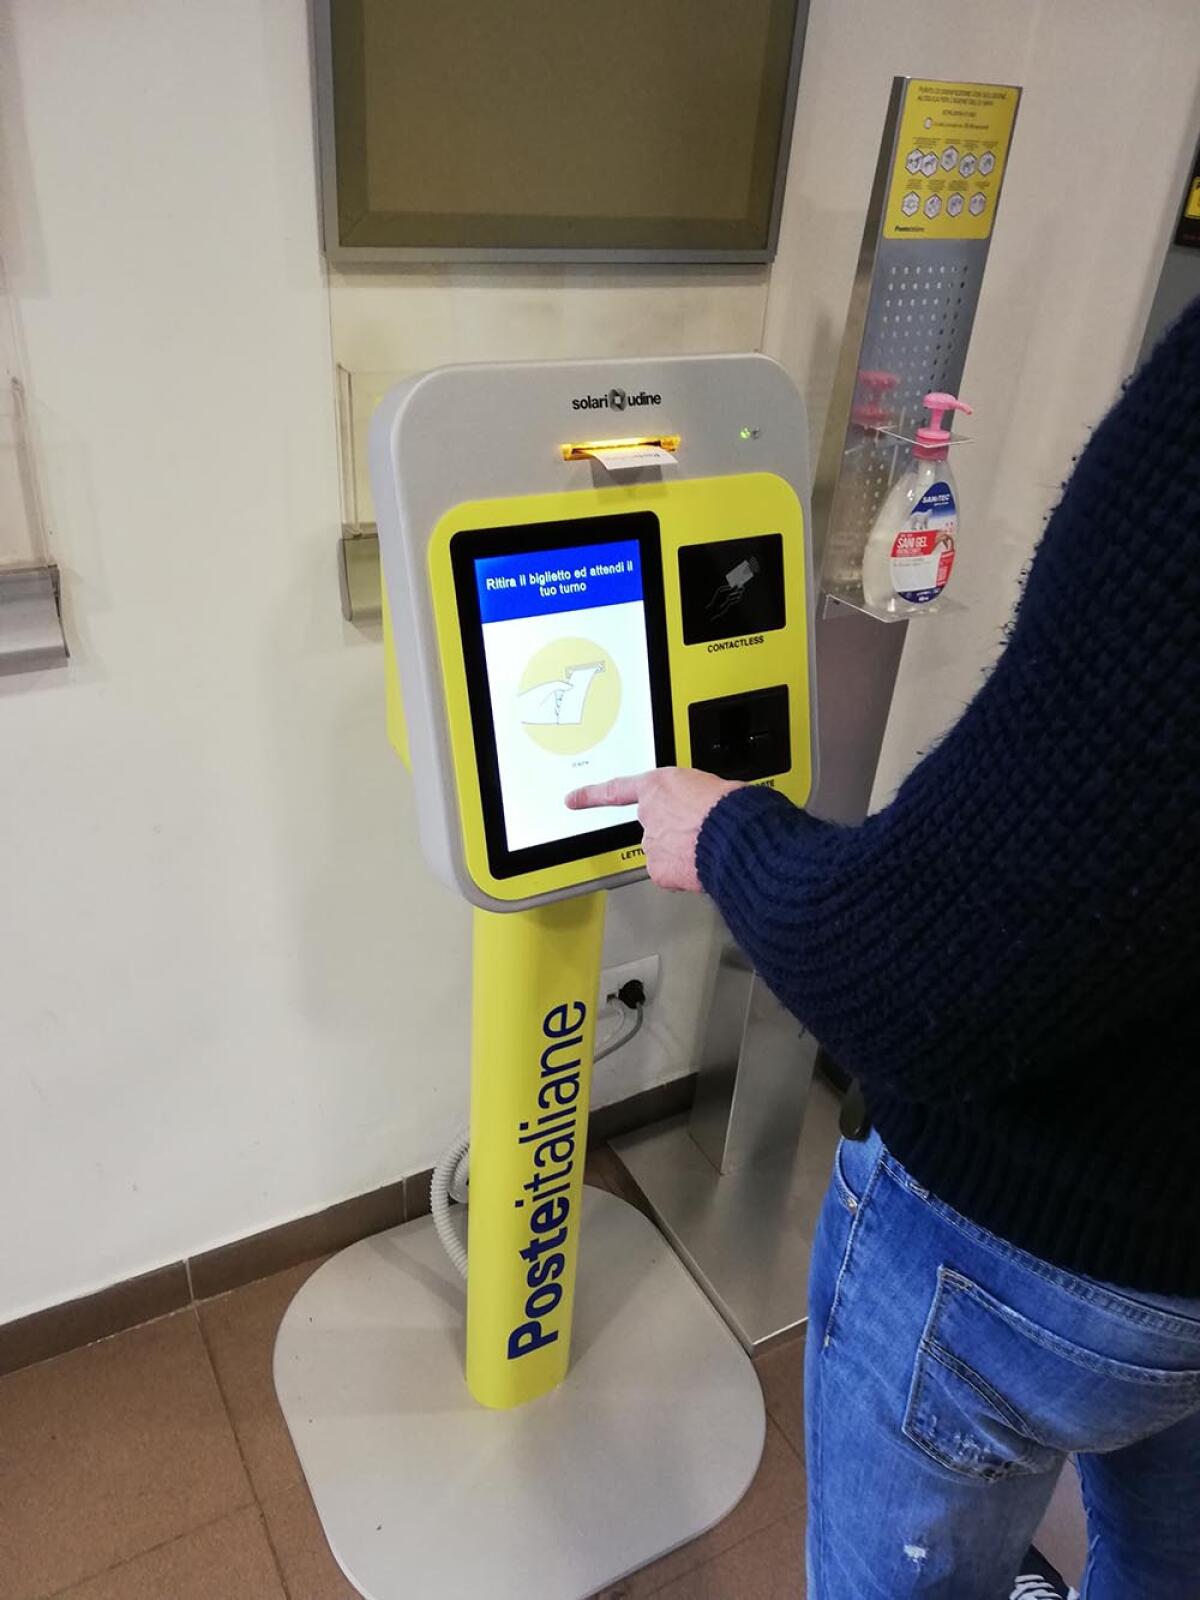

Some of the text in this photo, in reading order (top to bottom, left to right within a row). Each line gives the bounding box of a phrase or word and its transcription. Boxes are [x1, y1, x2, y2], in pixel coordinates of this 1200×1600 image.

[572, 391, 662, 410] solari udine
[485, 560, 634, 591] Ritira il biglietto ed attendi il
[539, 582, 587, 597] tuo turno
[707, 635, 765, 654] CONTACTLESS
